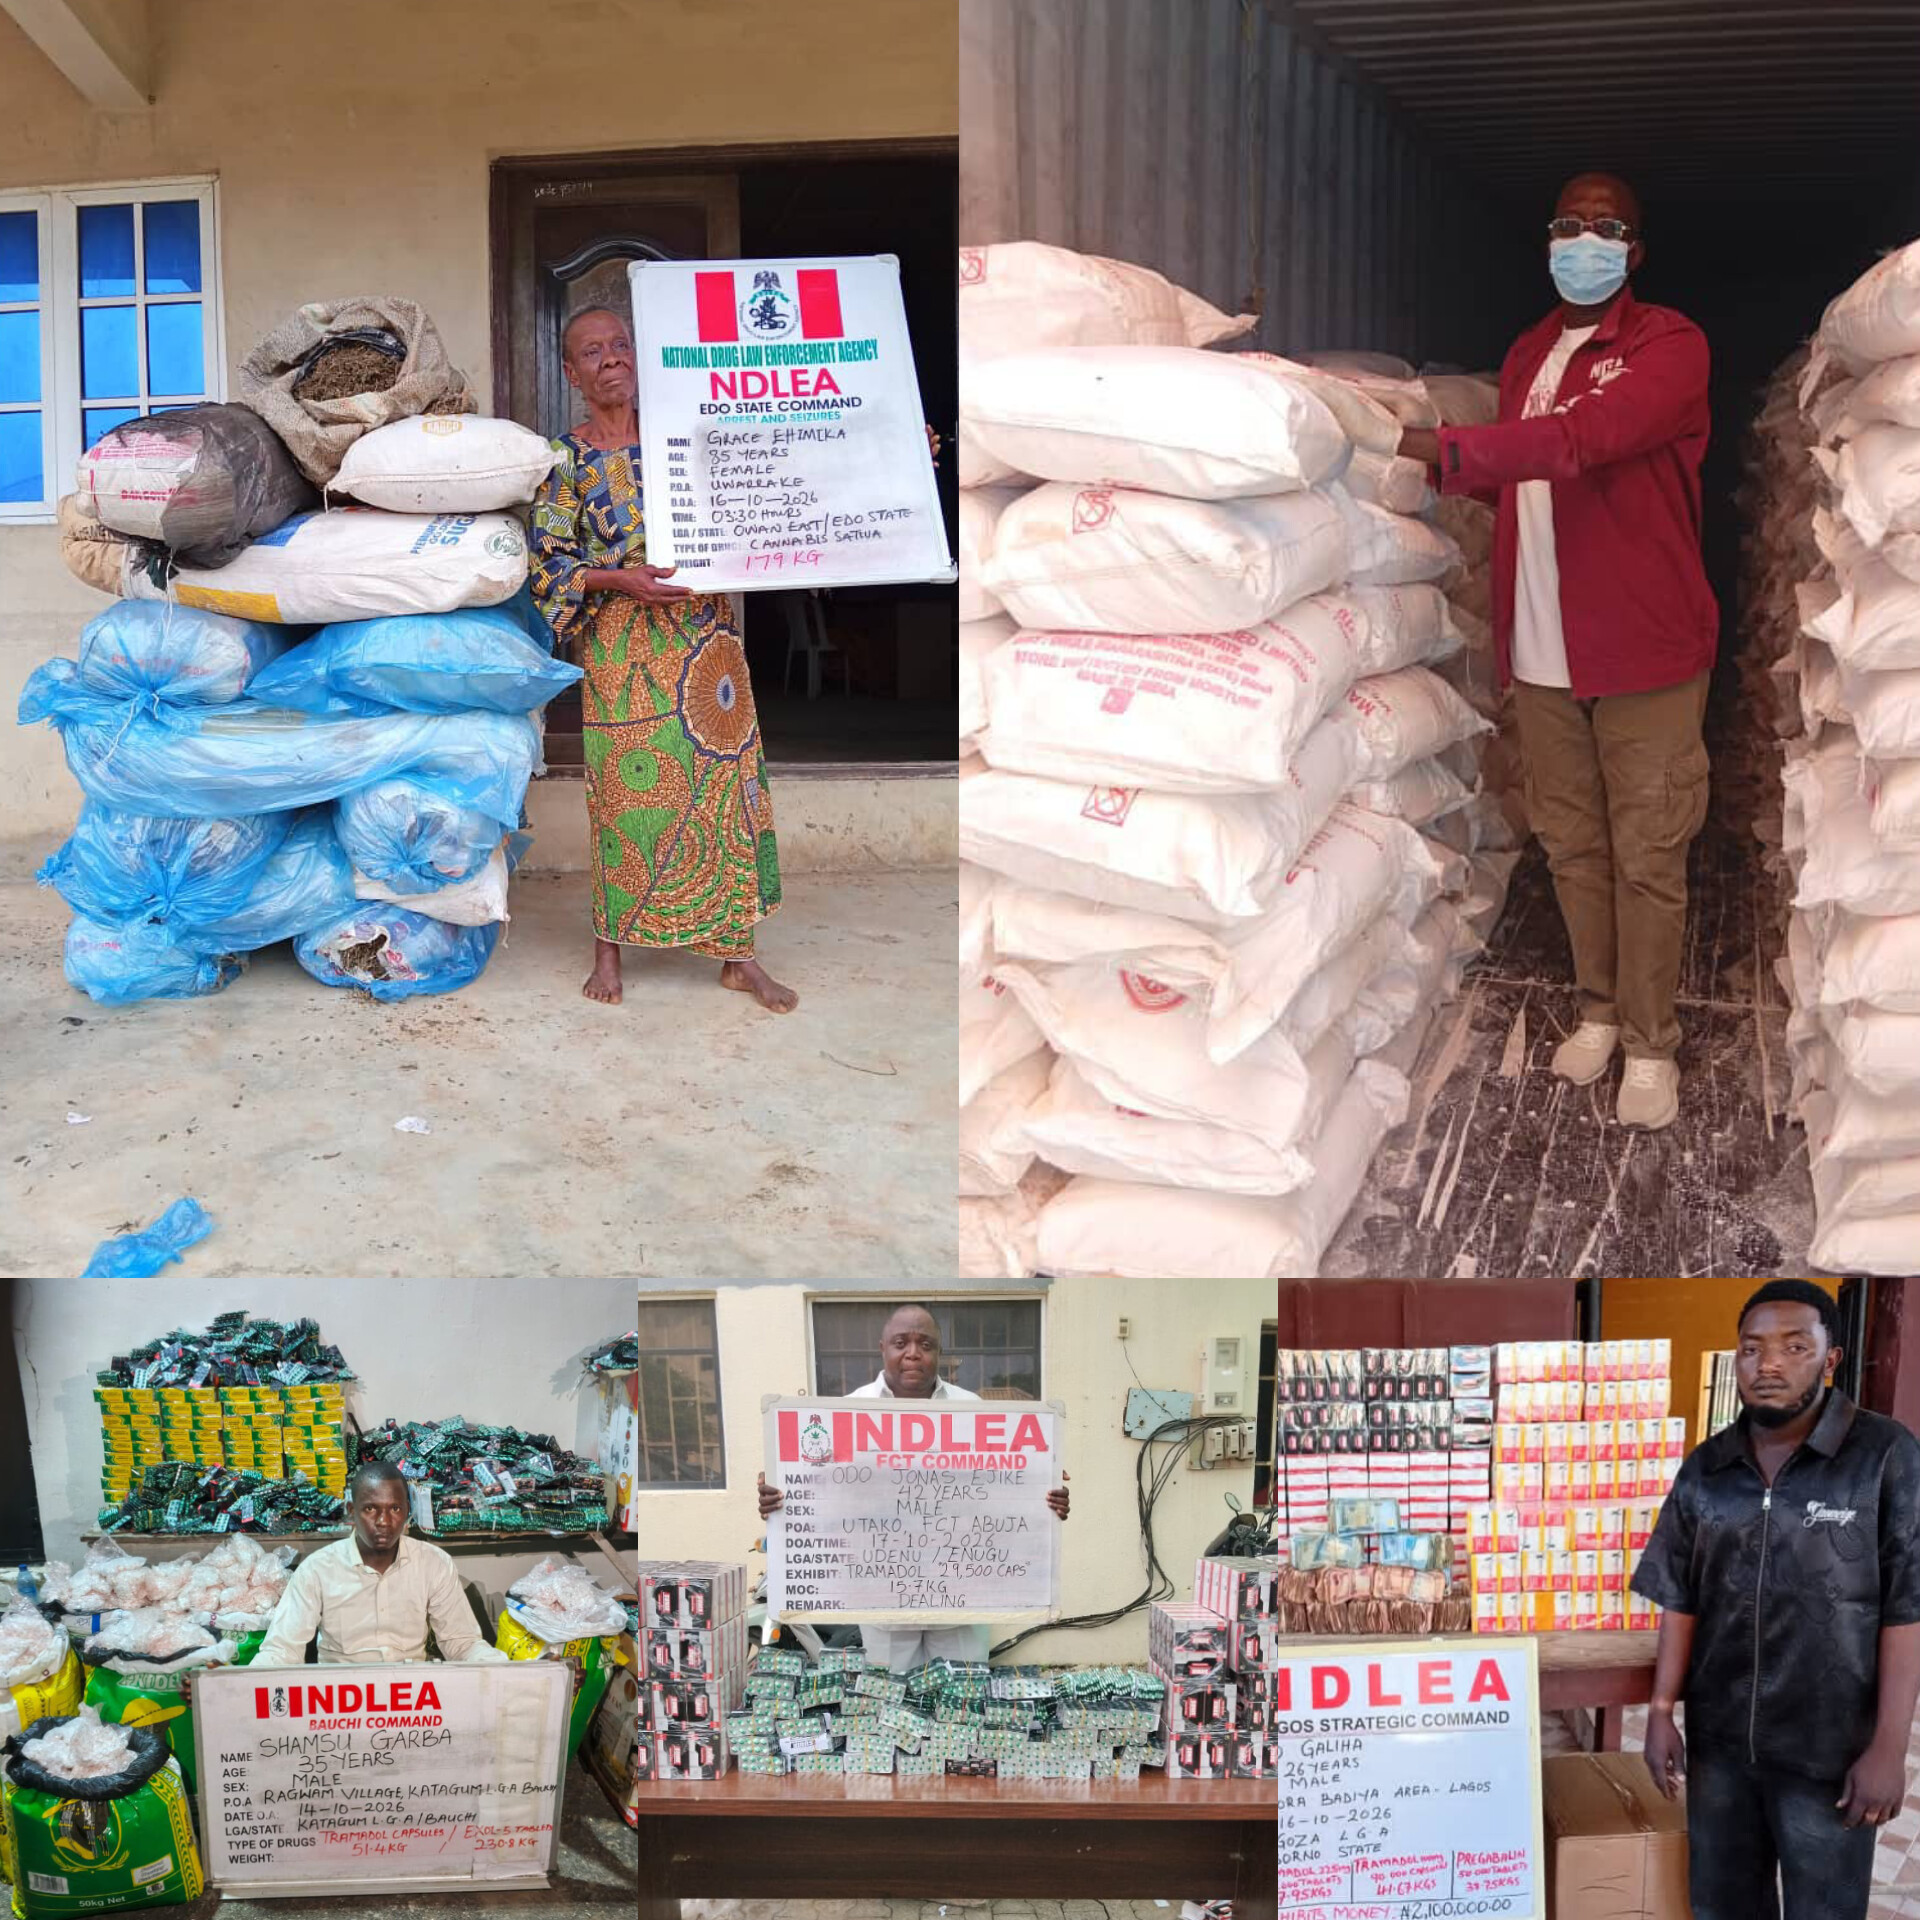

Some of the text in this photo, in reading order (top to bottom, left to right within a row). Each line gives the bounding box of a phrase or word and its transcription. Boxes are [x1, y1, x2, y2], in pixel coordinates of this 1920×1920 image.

[662, 338, 878, 368] NATIONAL DRUG LAW ENFORCEMENT AGENCY
[710, 368, 841, 400] NDLEA
[700, 396, 862, 415] EDO STATE COMMAND
[760, 413, 787, 424] AND
[790, 410, 841, 423] SEIZURES
[707, 430, 766, 448] GRACE
[737, 448, 789, 462] YEARS
[709, 465, 776, 478] FEMALE
[711, 510, 757, 524] 03:30
[733, 522, 782, 538] OWAN
[868, 508, 915, 523] STATE
[674, 544, 695, 553] TYPE
[697, 543, 711, 553] OF
[750, 534, 829, 550] CANNABIS
[745, 550, 824, 571] 179 KG
[856, 1413, 1049, 1453] NDLEA
[876, 1453, 1027, 1470] FCT COMMAND
[832, 1465, 1025, 1486] ODO JONAS EJIKE
[785, 1489, 815, 1500] AGE:
[898, 1484, 989, 1501] 42 YEARS
[785, 1505, 815, 1516] SEX:
[897, 1499, 943, 1516] MALE
[785, 1522, 815, 1533] POA:
[923, 1515, 960, 1532] FCT
[971, 1515, 1029, 1533] ABUJA
[785, 1538, 851, 1549] DOA/TIME:
[862, 1549, 921, 1564] UDENU
[947, 1547, 1009, 1563] ENUGU
[785, 1569, 842, 1580] EXHIBIT:
[844, 1563, 927, 1579] TRAMADOL
[785, 1584, 819, 1595] MOC:
[785, 1600, 846, 1611] REMARK:
[899, 1593, 966, 1609] DEALING
[308, 1681, 442, 1714] NDLEA
[309, 1715, 443, 1731] BAUCHI COMMAND
[1320, 1714, 1416, 1732] STRATEGIC
[1421, 1711, 1510, 1727] COMMAND
[260, 1729, 452, 1758] SHAMSU GARBA
[1301, 1738, 1363, 1758] GALIHA
[221, 1752, 253, 1763] NAME
[299, 1751, 395, 1774] 35 YEARS
[1284, 1757, 1360, 1778] 26 YEARS
[223, 1782, 249, 1793] SEX:
[292, 1773, 343, 1789] MALE
[1290, 1773, 1342, 1790] MALE
[408, 1783, 482, 1800] KATAGUM
[1321, 1788, 1380, 1807] BADIYA
[1449, 1781, 1492, 1794] LAGOS
[224, 1811, 254, 1822] DATE
[297, 1816, 367, 1832] KATAGUM
[228, 1837, 316, 1850] TYPE OF DRUGS
[319, 1830, 388, 1845] TRAMADOL
[392, 1827, 445, 1840] CAPSULES
[518, 1838, 539, 1847] KG
[229, 1853, 274, 1864] WEIGHT:
[1338, 1843, 1382, 1858] STATE
[78, 1896, 126, 1909] 50kg Net
